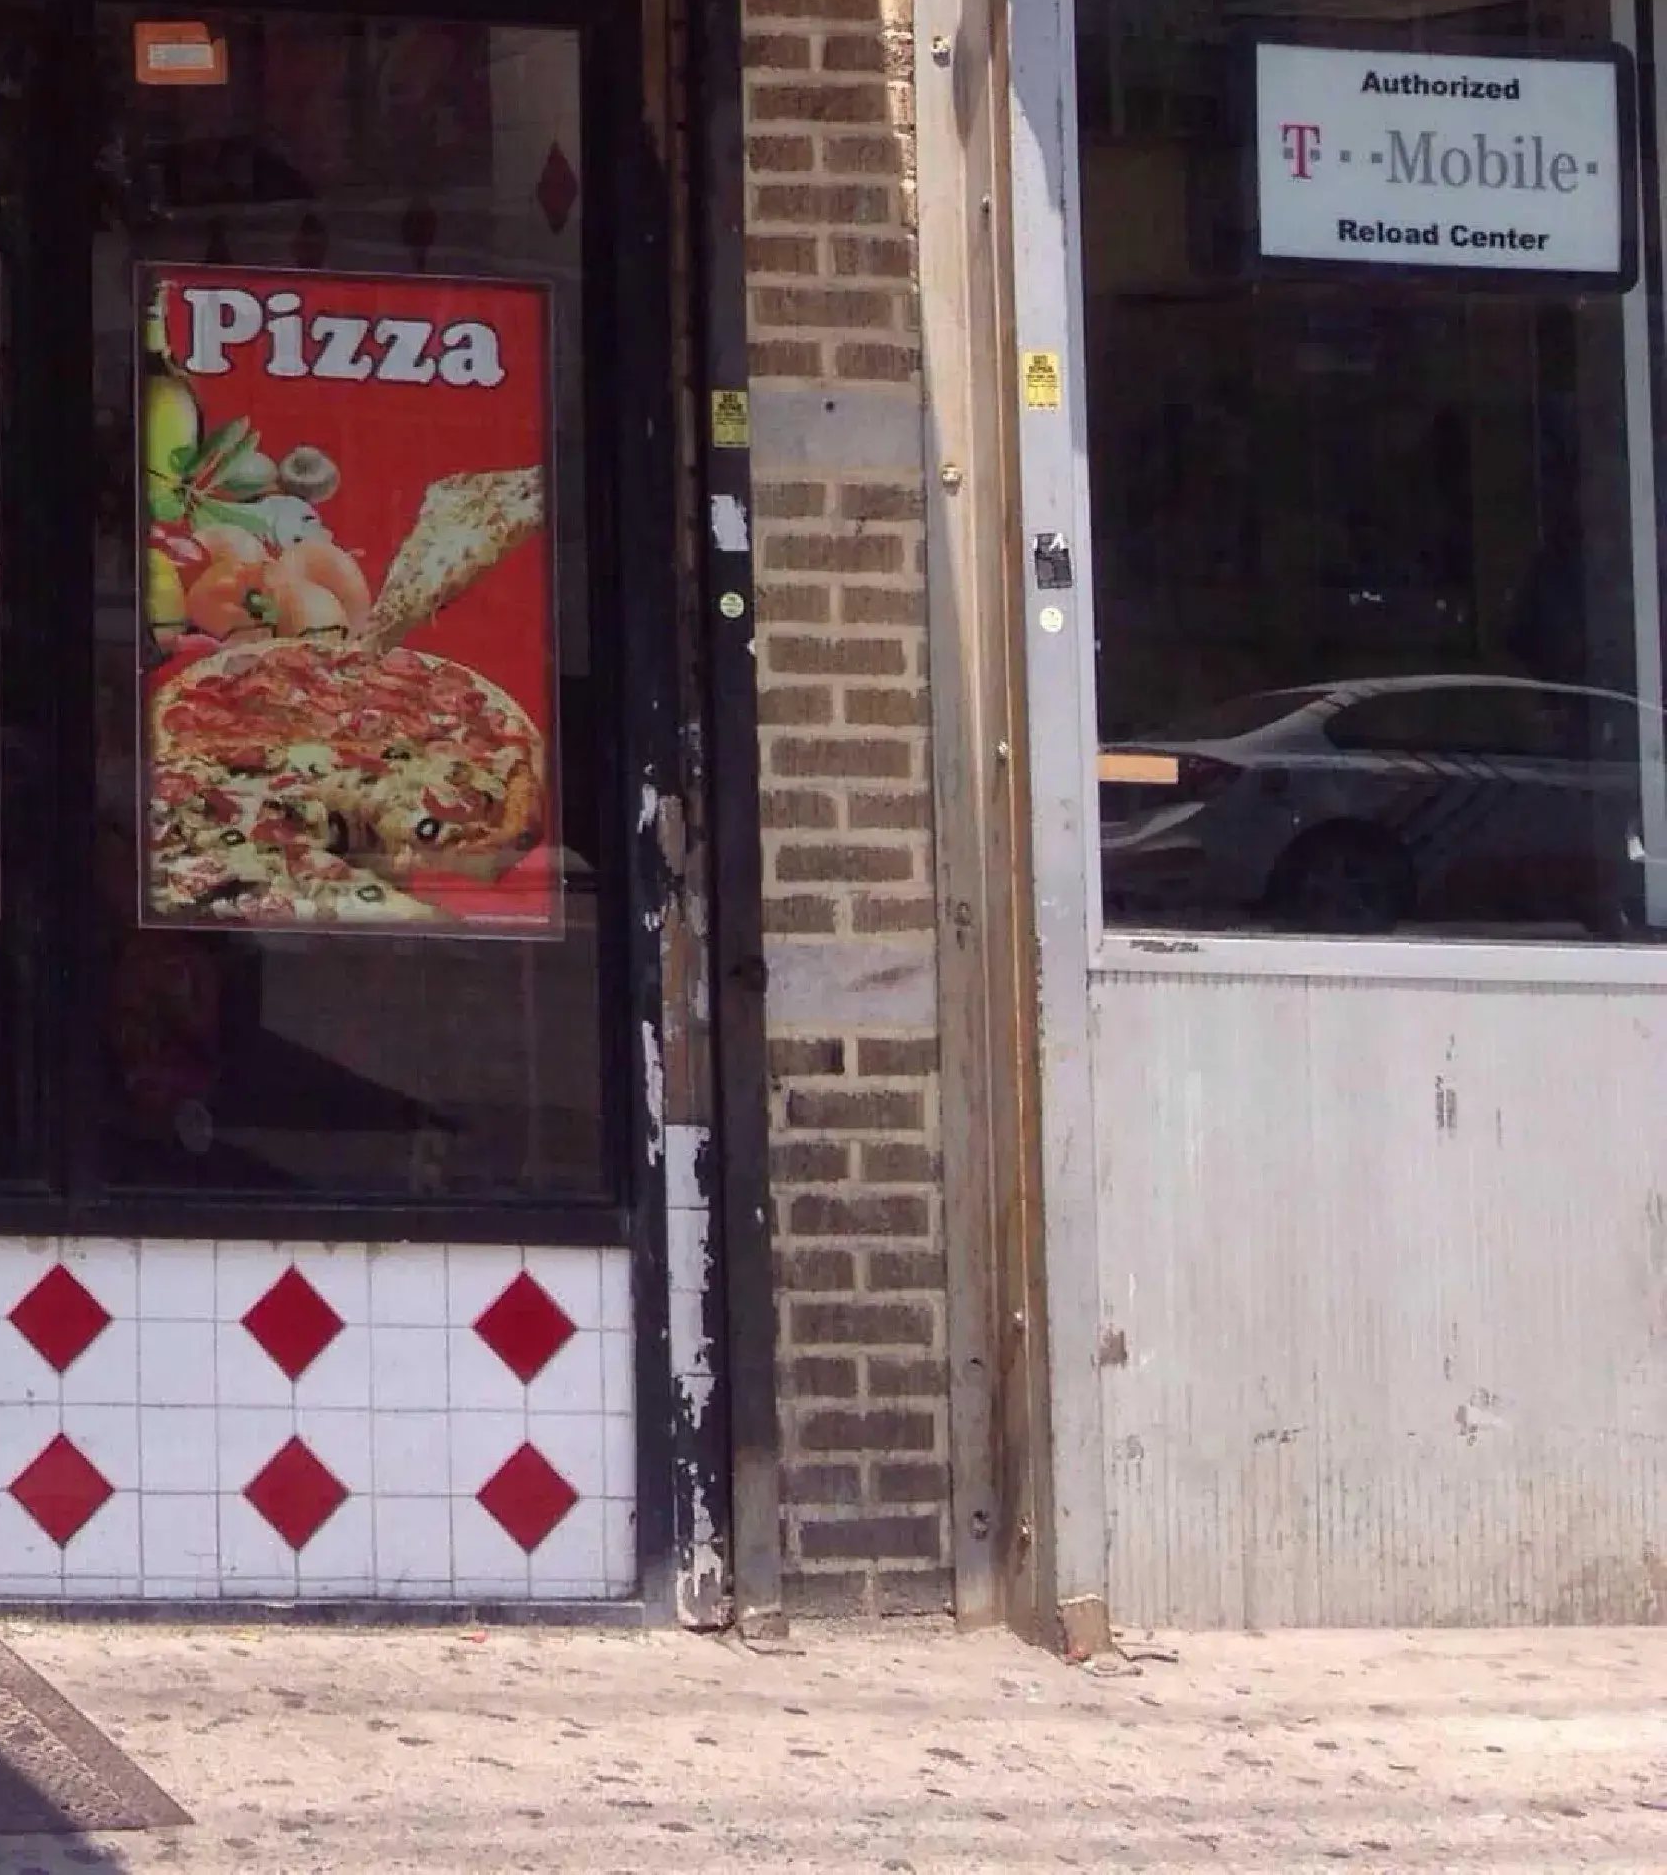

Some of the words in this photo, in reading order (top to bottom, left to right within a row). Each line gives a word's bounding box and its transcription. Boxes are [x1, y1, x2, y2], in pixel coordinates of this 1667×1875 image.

[1360, 71, 1520, 100] Authorized
[1337, 219, 1439, 246] Reload
[1450, 225, 1550, 252] Center
[183, 288, 505, 386] Pizza
